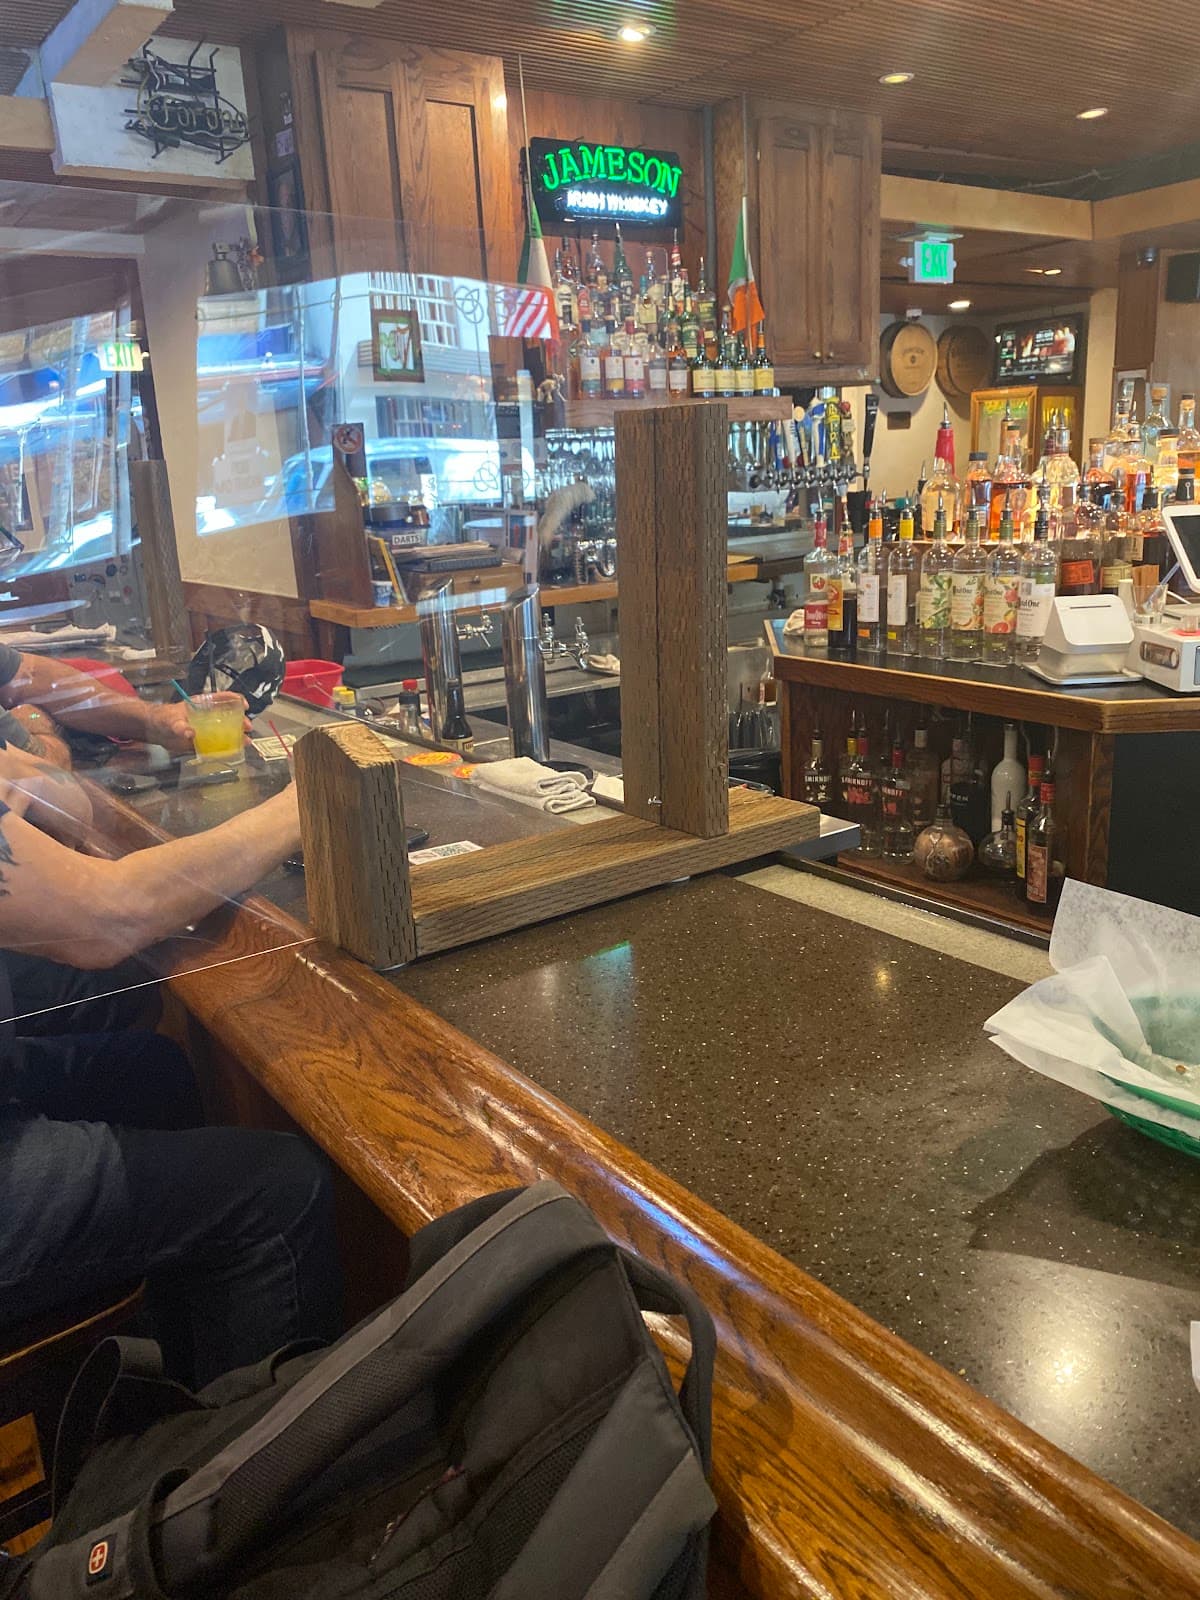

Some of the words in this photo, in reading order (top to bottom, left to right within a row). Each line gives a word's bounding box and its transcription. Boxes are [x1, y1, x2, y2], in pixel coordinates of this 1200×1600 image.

[542, 145, 682, 198] JAMESON
[921, 242, 948, 278] EXIT
[103, 342, 135, 367] EXIT
[394, 535, 421, 545] DARTS
